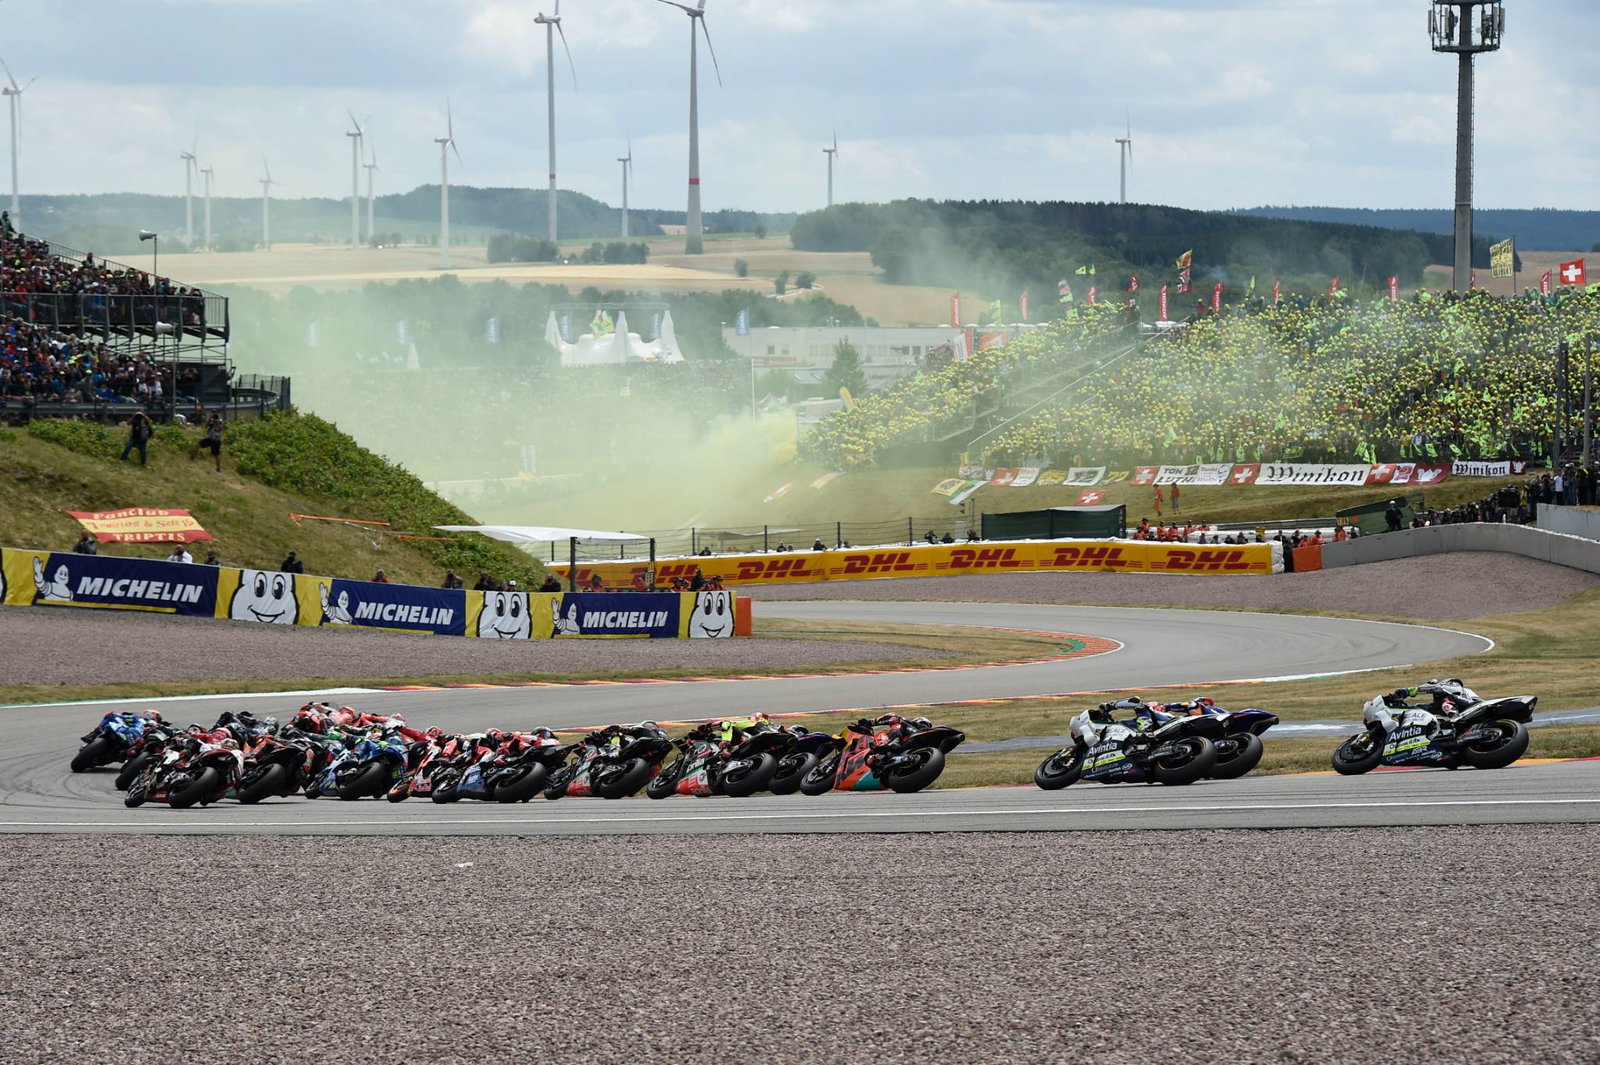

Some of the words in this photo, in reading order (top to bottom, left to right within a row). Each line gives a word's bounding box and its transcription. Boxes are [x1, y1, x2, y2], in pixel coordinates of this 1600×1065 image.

[1267, 465, 1364, 483] Winikon
[1454, 463, 1506, 476] Winikon
[112, 532, 186, 541] TRIPTIS
[844, 552, 918, 574] DHL
[950, 548, 1025, 569] DHL
[1050, 547, 1128, 568] DHL
[1166, 550, 1250, 570] DHL
[737, 558, 812, 580] DHL
[76, 576, 203, 603] MICHELIN
[354, 601, 454, 626] MICHELIN
[582, 610, 668, 628] MICHELIN
